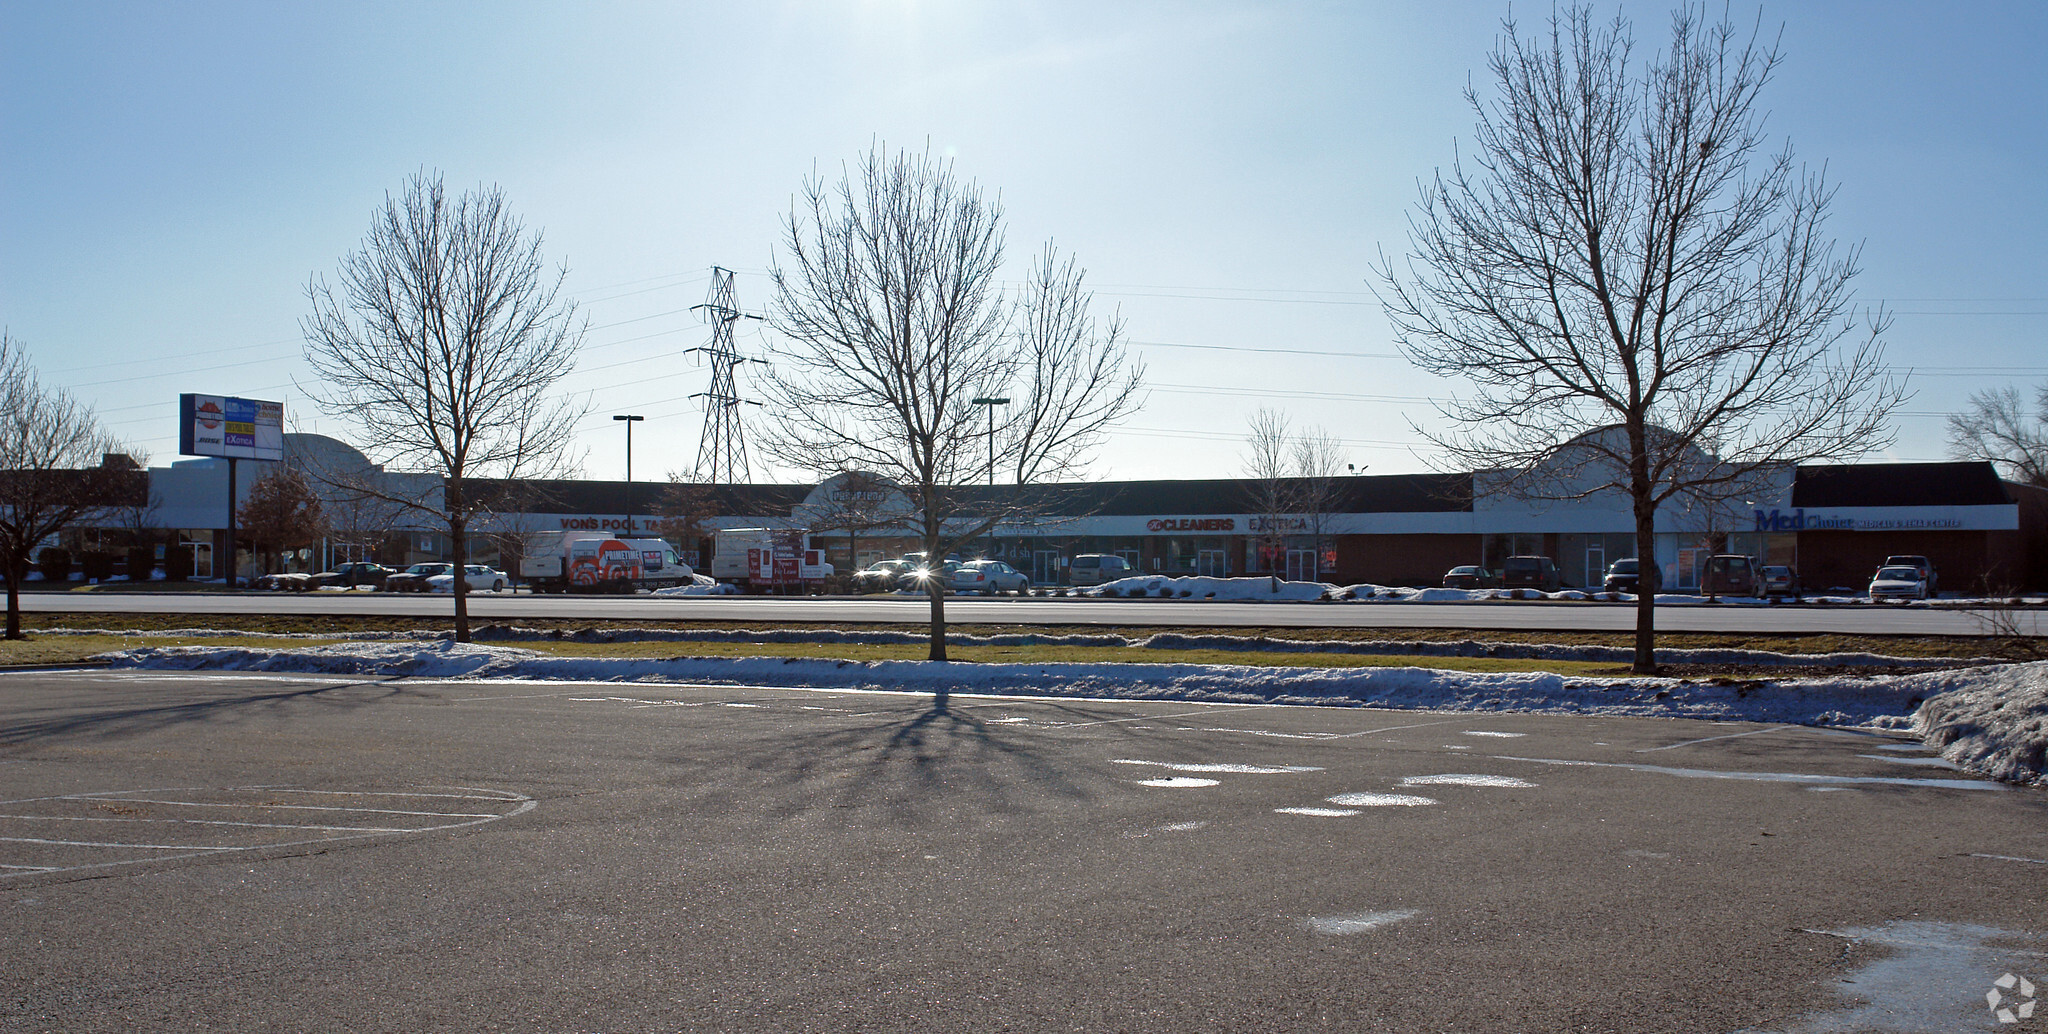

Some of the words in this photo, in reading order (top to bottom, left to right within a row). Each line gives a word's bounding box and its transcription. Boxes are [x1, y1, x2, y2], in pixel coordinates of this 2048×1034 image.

[560, 517, 599, 530] VON'S
[602, 519, 640, 530] POOL
[1163, 518, 1234, 531] CLEANERS
[1249, 516, 1307, 531] EXOTICA
[604, 550, 640, 560] PRIMETIME
[1010, 546, 1031, 558] dsh
